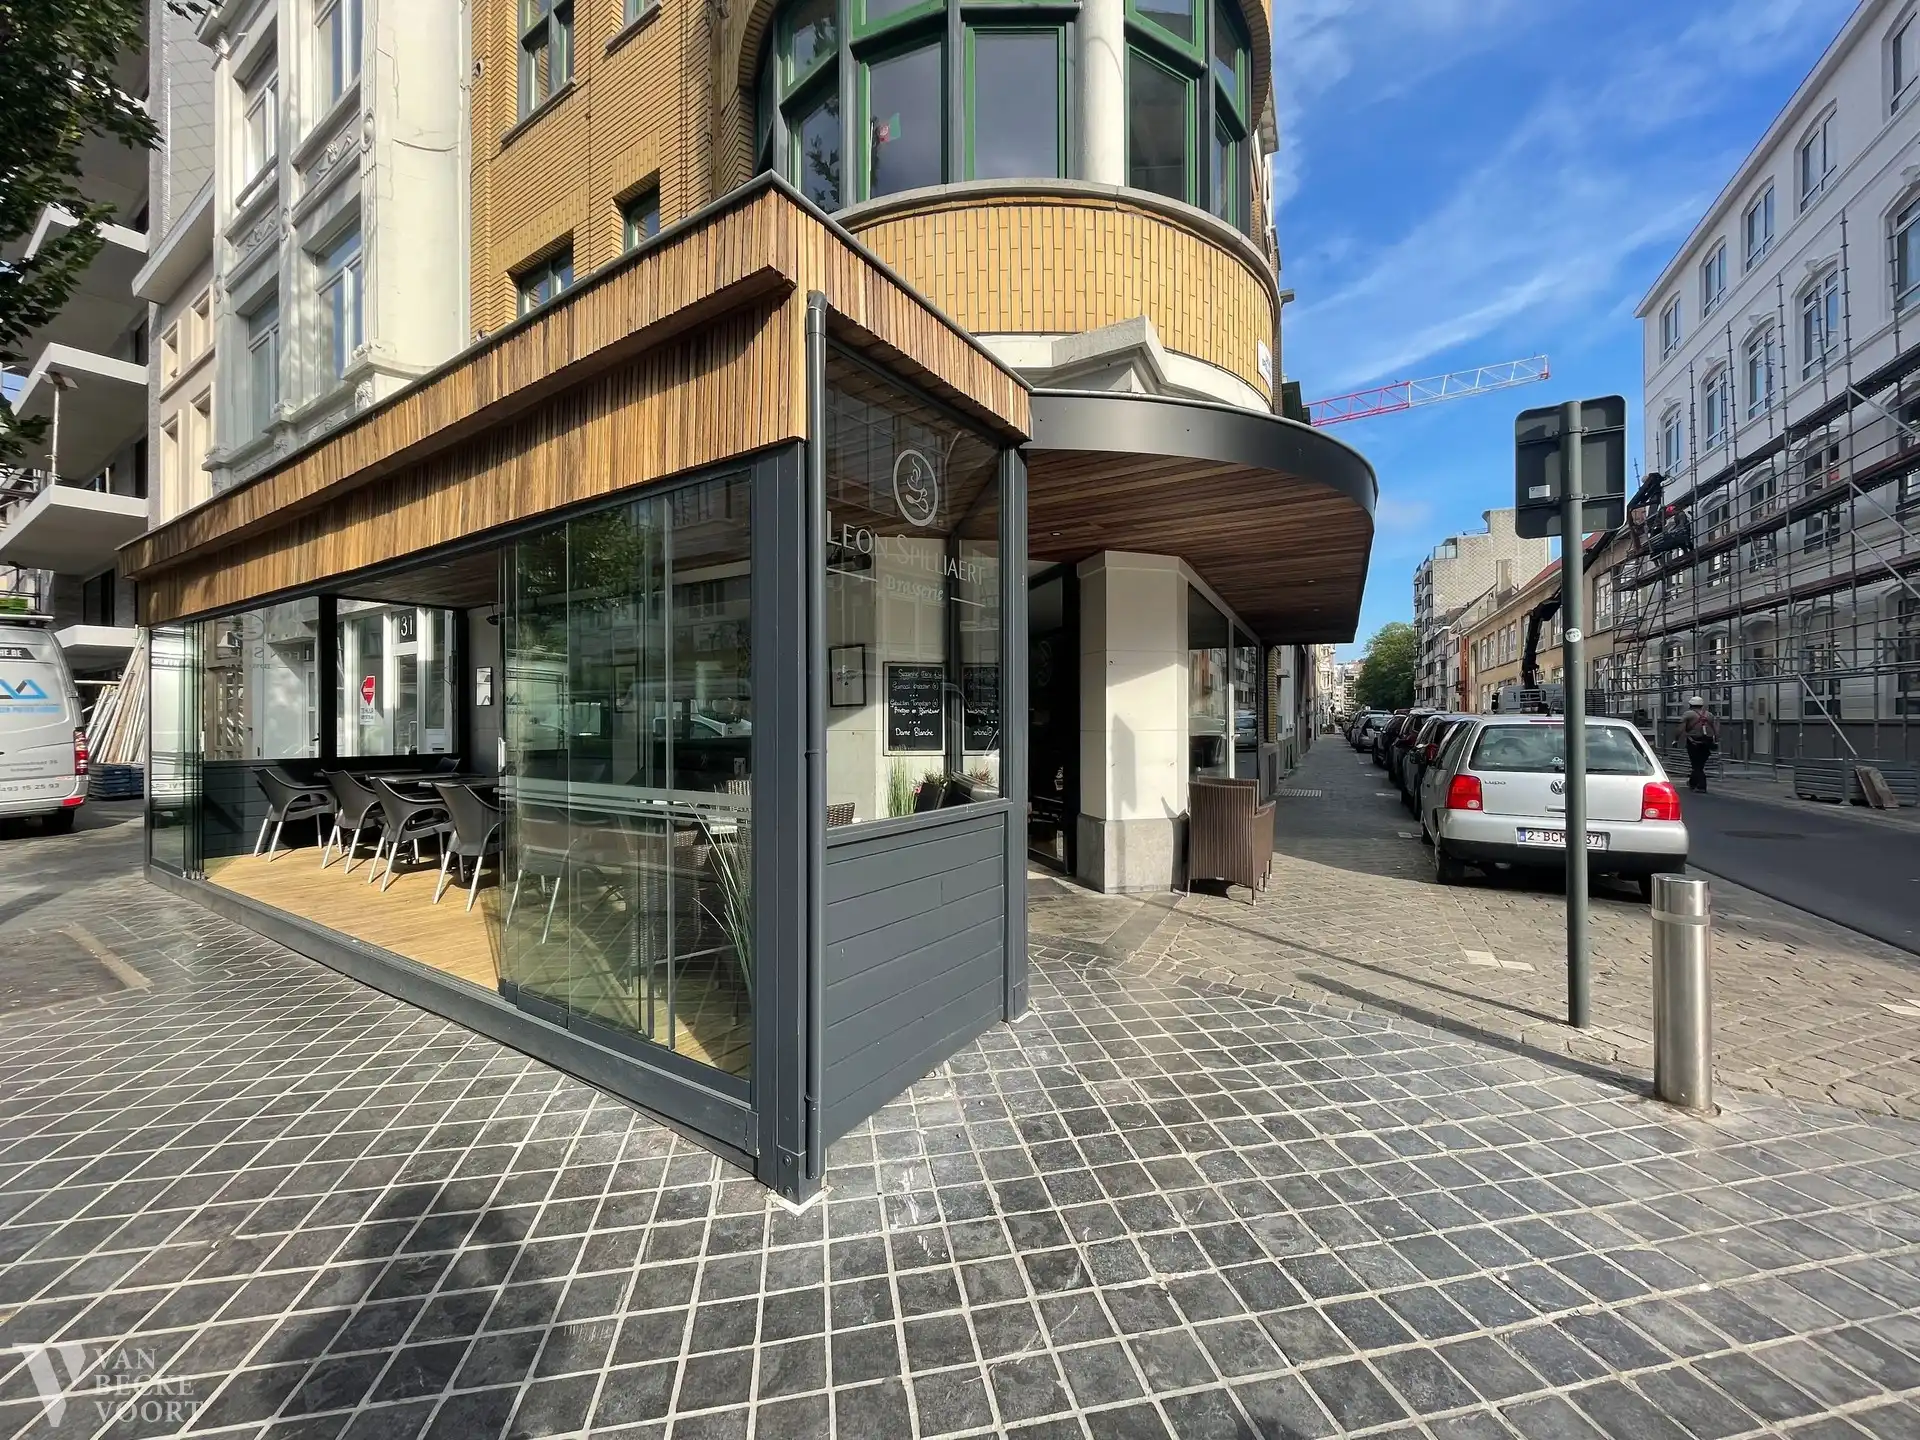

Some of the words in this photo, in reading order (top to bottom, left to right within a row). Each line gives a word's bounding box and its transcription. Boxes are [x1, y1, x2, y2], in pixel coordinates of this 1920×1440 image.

[827, 510, 888, 559] LEON
[896, 533, 986, 586] SPILLIAERT
[886, 574, 944, 601] Brasserie
[400, 615, 413, 637] 31
